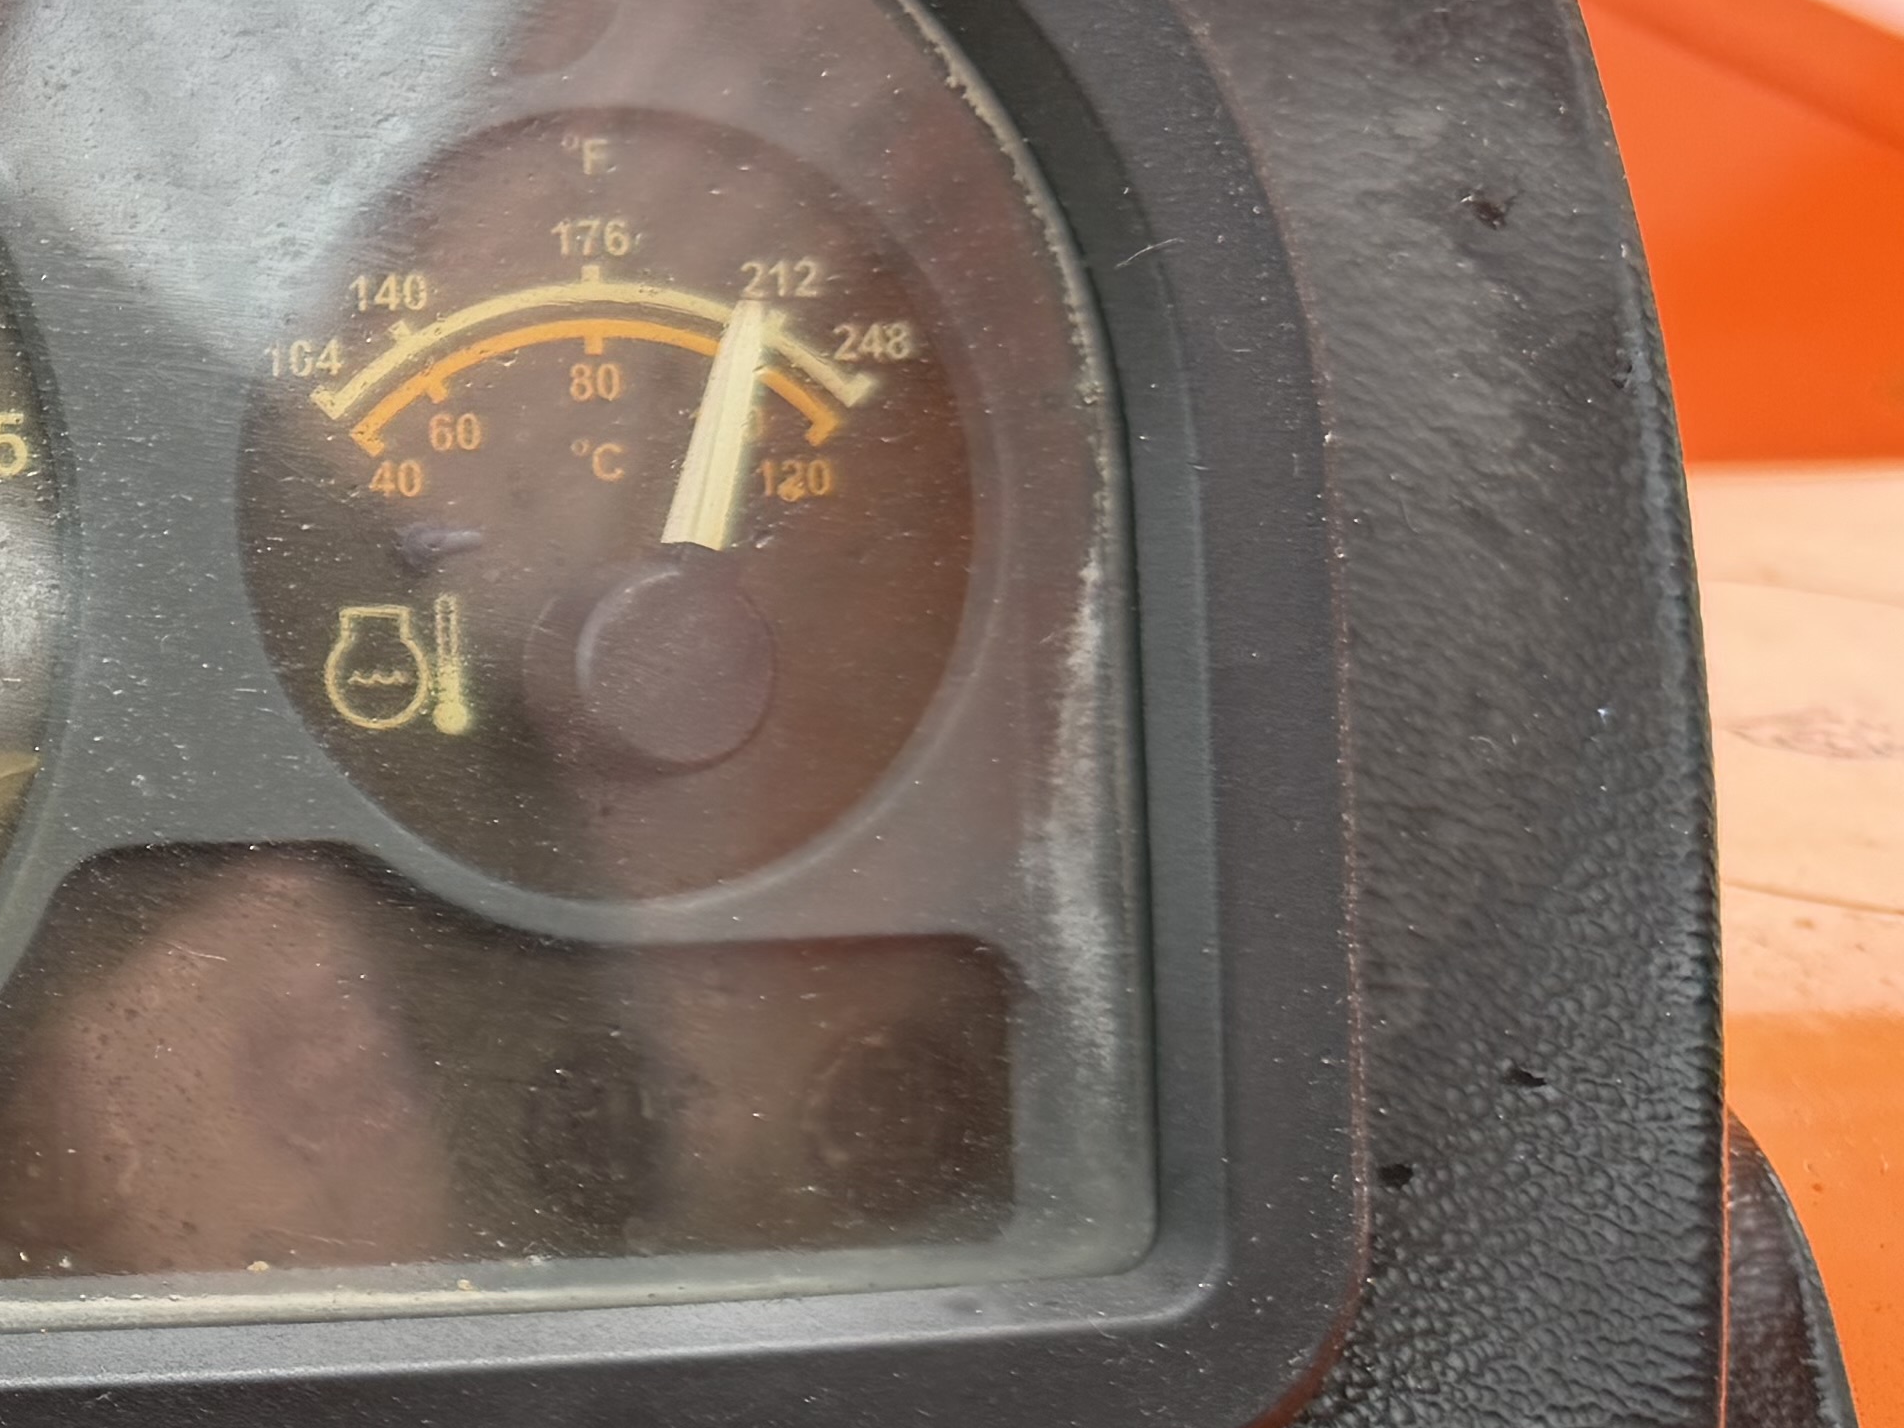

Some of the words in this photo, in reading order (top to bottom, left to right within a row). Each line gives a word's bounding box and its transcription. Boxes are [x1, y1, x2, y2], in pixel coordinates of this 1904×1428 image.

[550, 218, 631, 259] 176
[348, 271, 428, 312] 140
[740, 260, 819, 299] 212
[833, 320, 913, 362] 248
[569, 362, 622, 403] 80
[428, 412, 482, 453] 60
[368, 458, 424, 499] 40
[757, 458, 832, 502] 120
